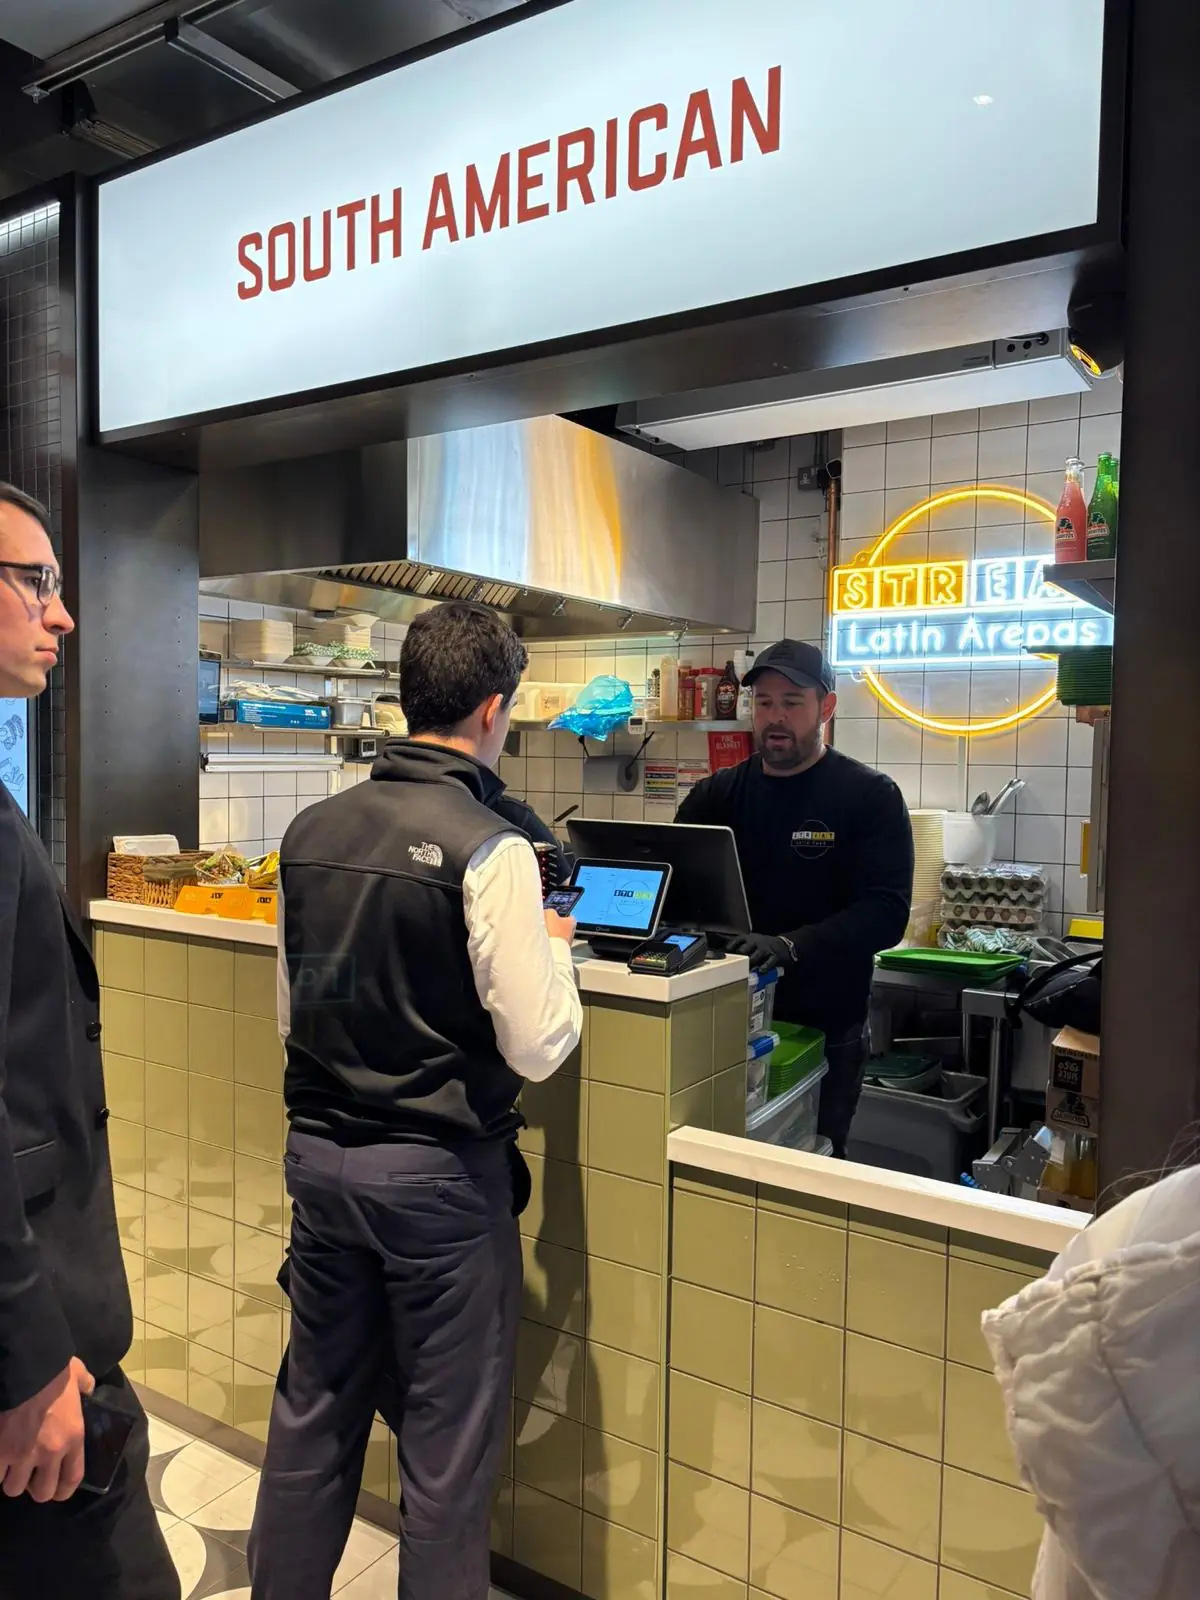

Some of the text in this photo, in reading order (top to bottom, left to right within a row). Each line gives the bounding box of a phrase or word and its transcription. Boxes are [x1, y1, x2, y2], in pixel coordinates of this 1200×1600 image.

[237, 65, 781, 300] SOUTH AMERICAN
[843, 559, 1066, 609] STREA
[850, 615, 1098, 653] Latin Arepas
[408, 845, 433, 858] NORTH
[412, 853, 432, 864] FACE
